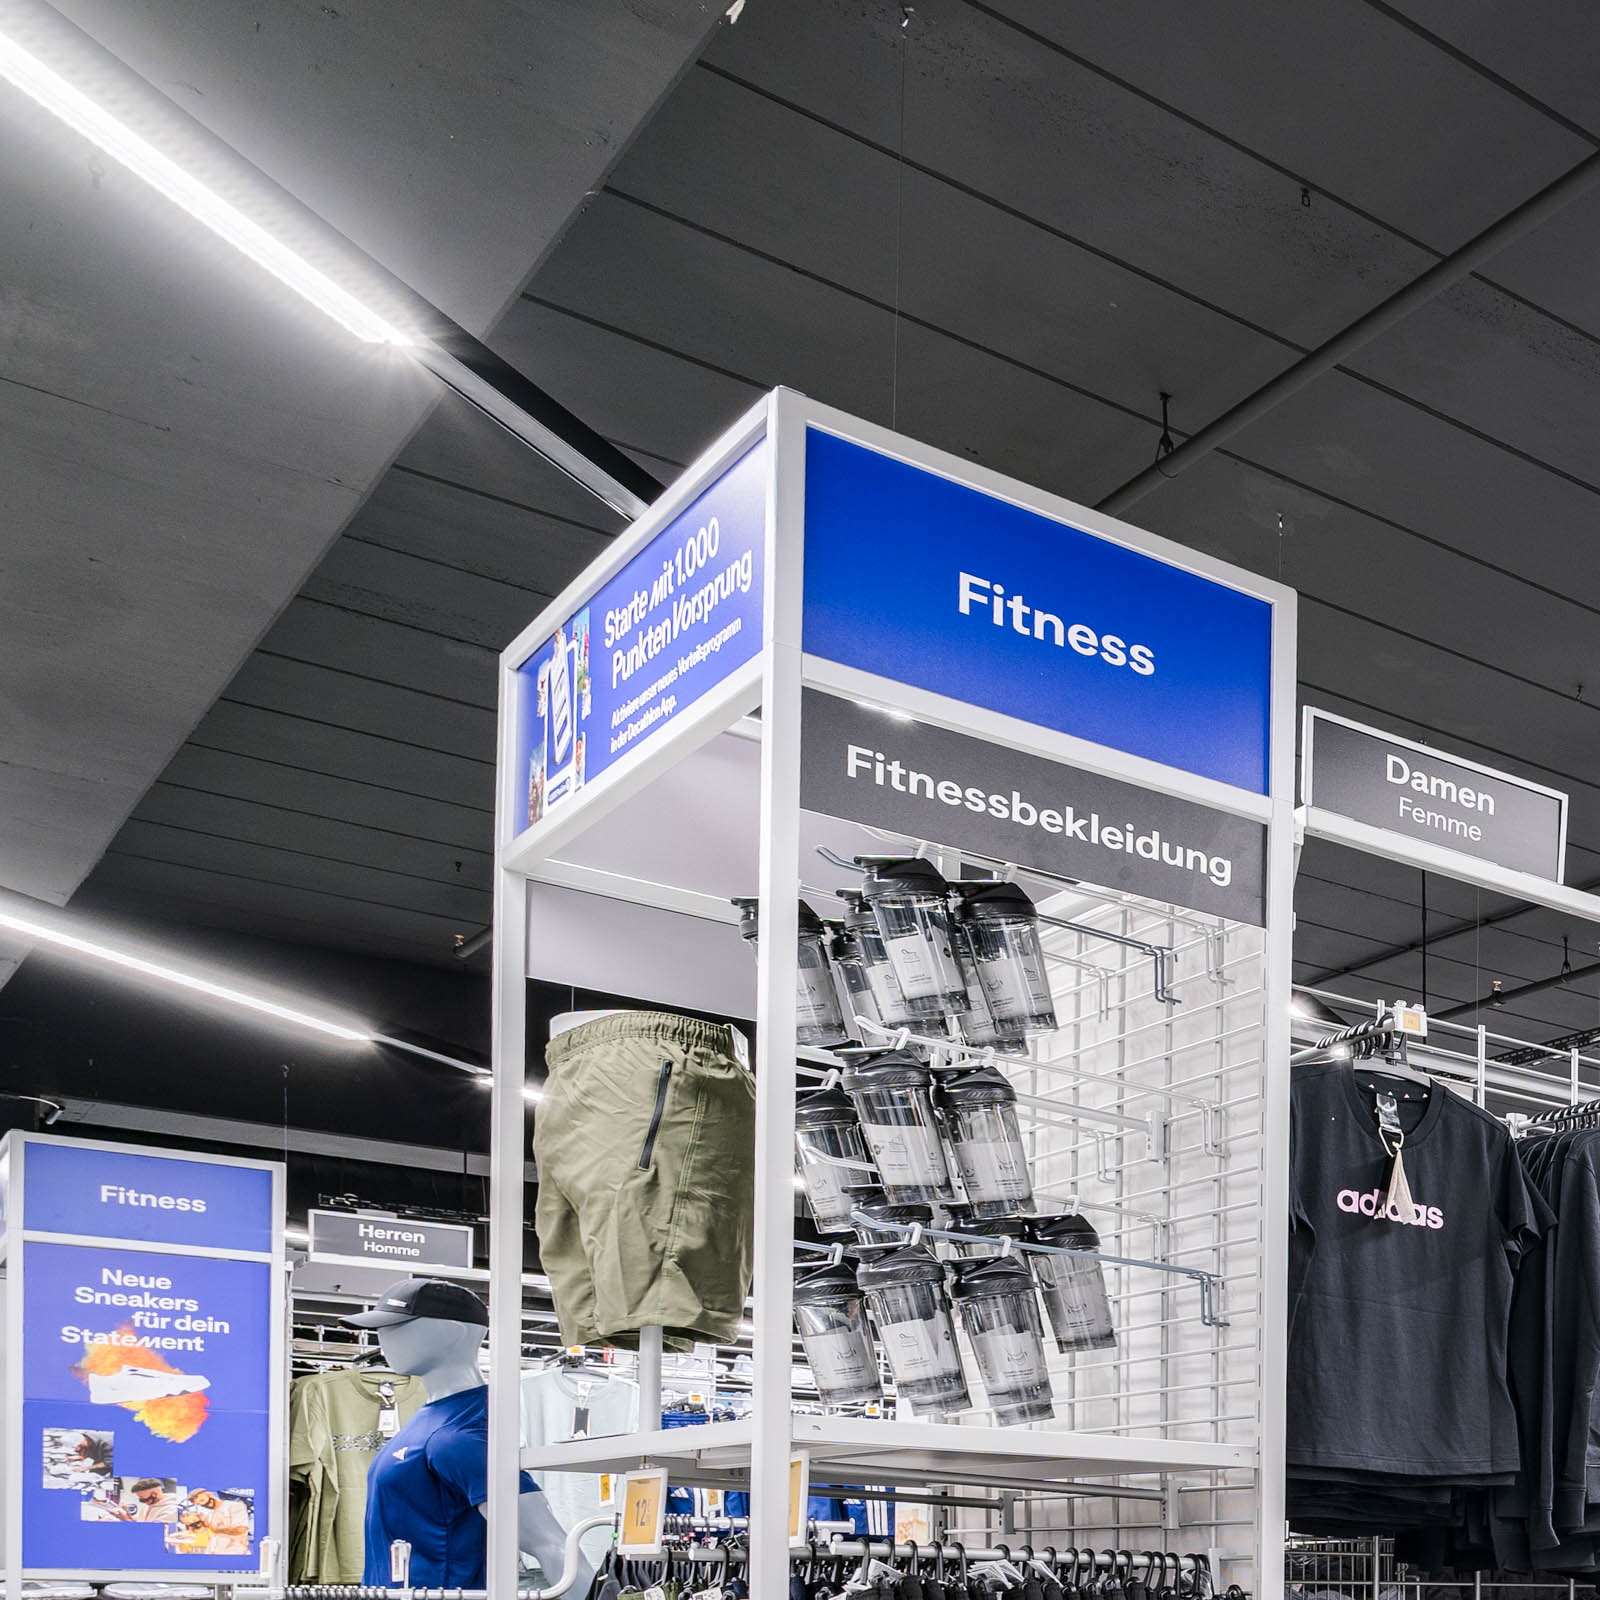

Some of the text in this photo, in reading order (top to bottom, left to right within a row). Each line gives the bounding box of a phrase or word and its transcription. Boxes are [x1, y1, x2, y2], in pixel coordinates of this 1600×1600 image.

[604, 516, 720, 648] Starte mit 1.000
[612, 549, 752, 689] Punkten Vorsprung
[957, 571, 1156, 677] Fitness
[611, 617, 742, 729] Aktiviere unser neues Vorteilsprogramm
[617, 730, 628, 750] der
[628, 706, 661, 741] Decathlon
[660, 695, 678, 717] App.
[1386, 753, 1495, 816] Damen
[845, 744, 1234, 888] Fitnessbekleidung
[1399, 796, 1482, 842] Femme
[101, 1185, 207, 1213] Fitness
[1336, 1188, 1444, 1229] adas
[358, 1223, 426, 1244] Herren
[363, 1240, 420, 1257] Homme
[74, 1286, 199, 1313] Sneakers
[101, 1268, 172, 1290] Neue
[60, 1325, 205, 1352] Statement
[131, 1310, 230, 1334] für dein
[636, 1498, 649, 1527] 12
